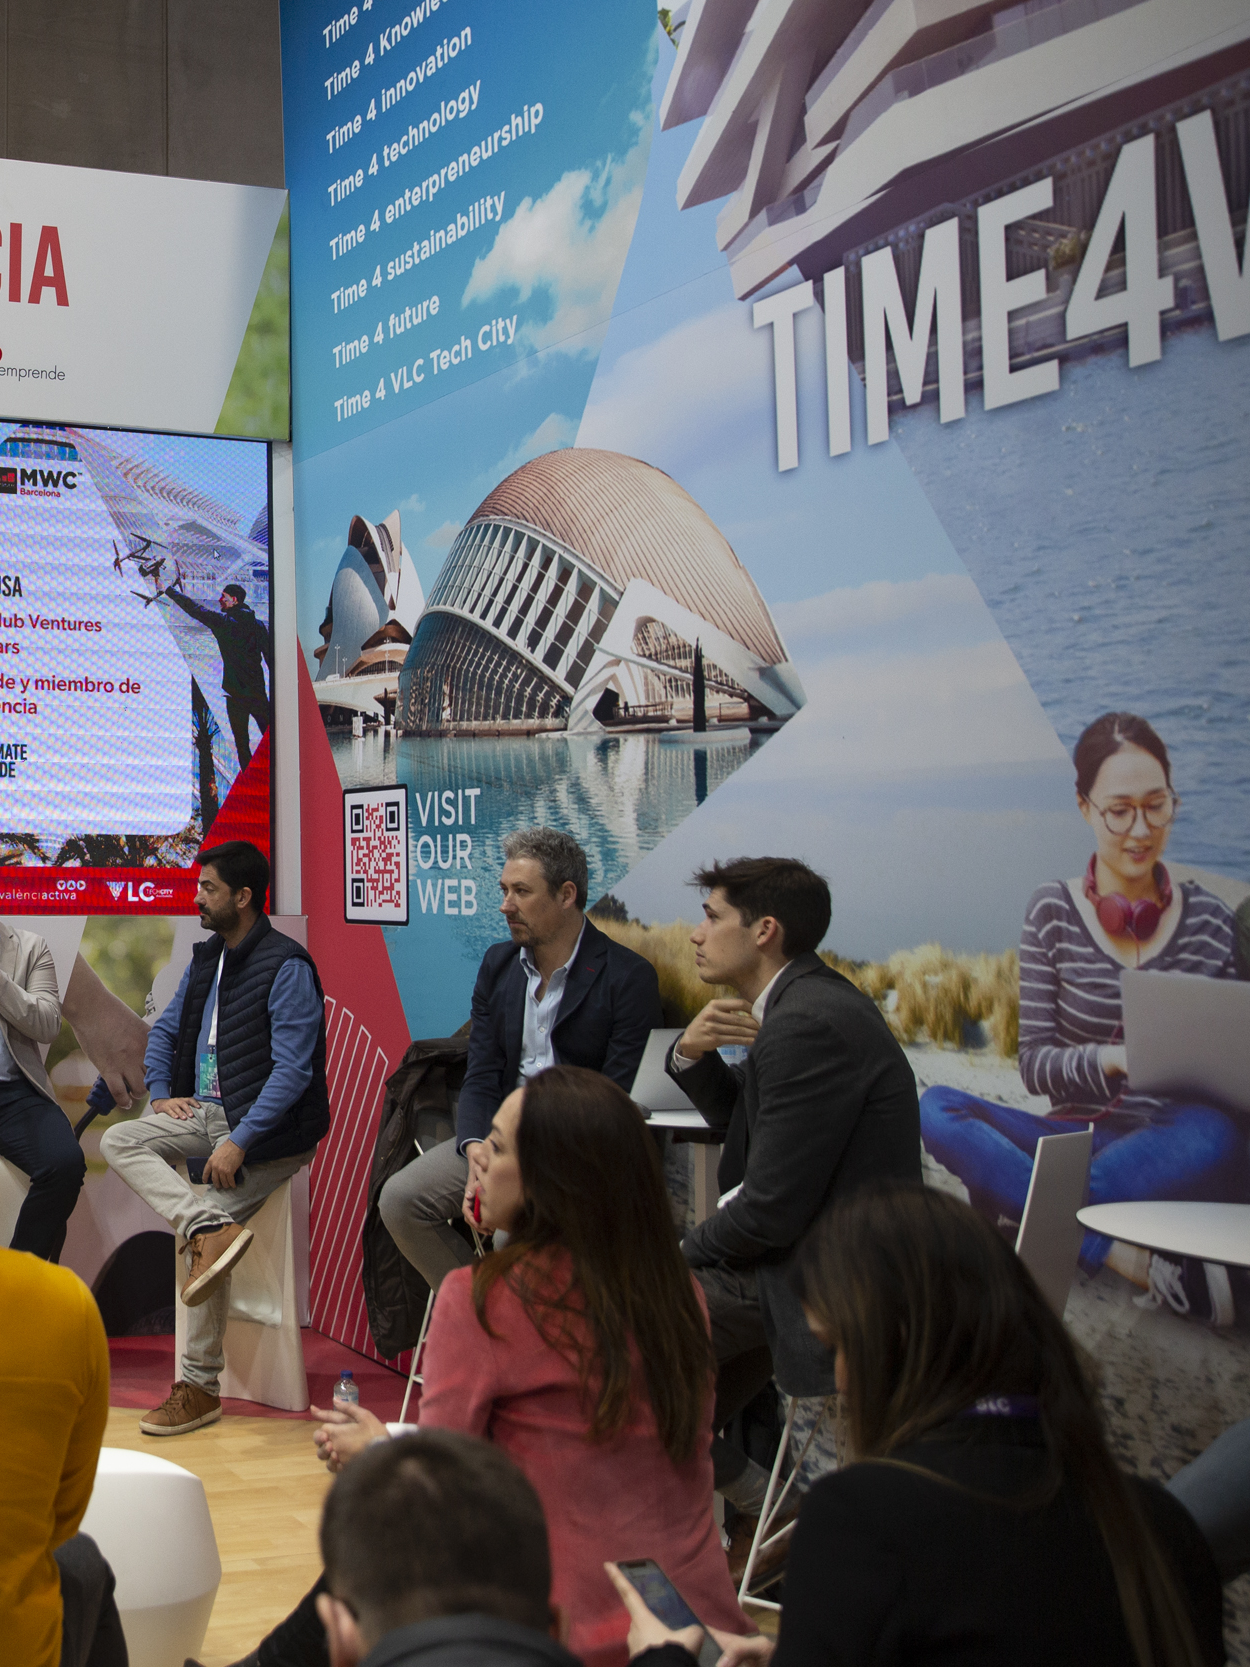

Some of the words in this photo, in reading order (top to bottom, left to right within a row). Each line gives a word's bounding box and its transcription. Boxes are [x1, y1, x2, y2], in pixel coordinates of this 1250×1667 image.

[322, 6, 359, 49] Time
[324, 59, 361, 101] Time
[364, 42, 375, 66] 4
[380, 0, 447, 57] Knowle
[326, 119, 362, 154] Time
[366, 98, 377, 122] 4
[381, 26, 472, 112] innovation
[327, 171, 363, 207] Time
[368, 153, 378, 177] 4
[383, 79, 481, 169] technology
[329, 225, 365, 261] Time
[370, 206, 380, 233] 4
[385, 101, 544, 225] enterpreneurship
[331, 278, 367, 314] Time
[371, 263, 382, 288] 4
[387, 190, 505, 281] sustainability
[753, 108, 1250, 473] TIME4V
[332, 333, 369, 369] Time
[373, 321, 384, 345] 4
[388, 294, 439, 339] future
[334, 389, 371, 422] Time
[375, 377, 386, 400] 4
[391, 358, 425, 394] VLC
[429, 330, 472, 376] Tech
[477, 314, 518, 353] City
[20, 488, 61, 498] Barcelona
[29, 614, 102, 633] Ventures
[20, 676, 31, 693] y
[35, 675, 115, 693] miembro
[119, 677, 141, 694] de
[415, 788, 481, 827] VISIT
[416, 833, 472, 869] OUR
[416, 879, 477, 916] WEB
